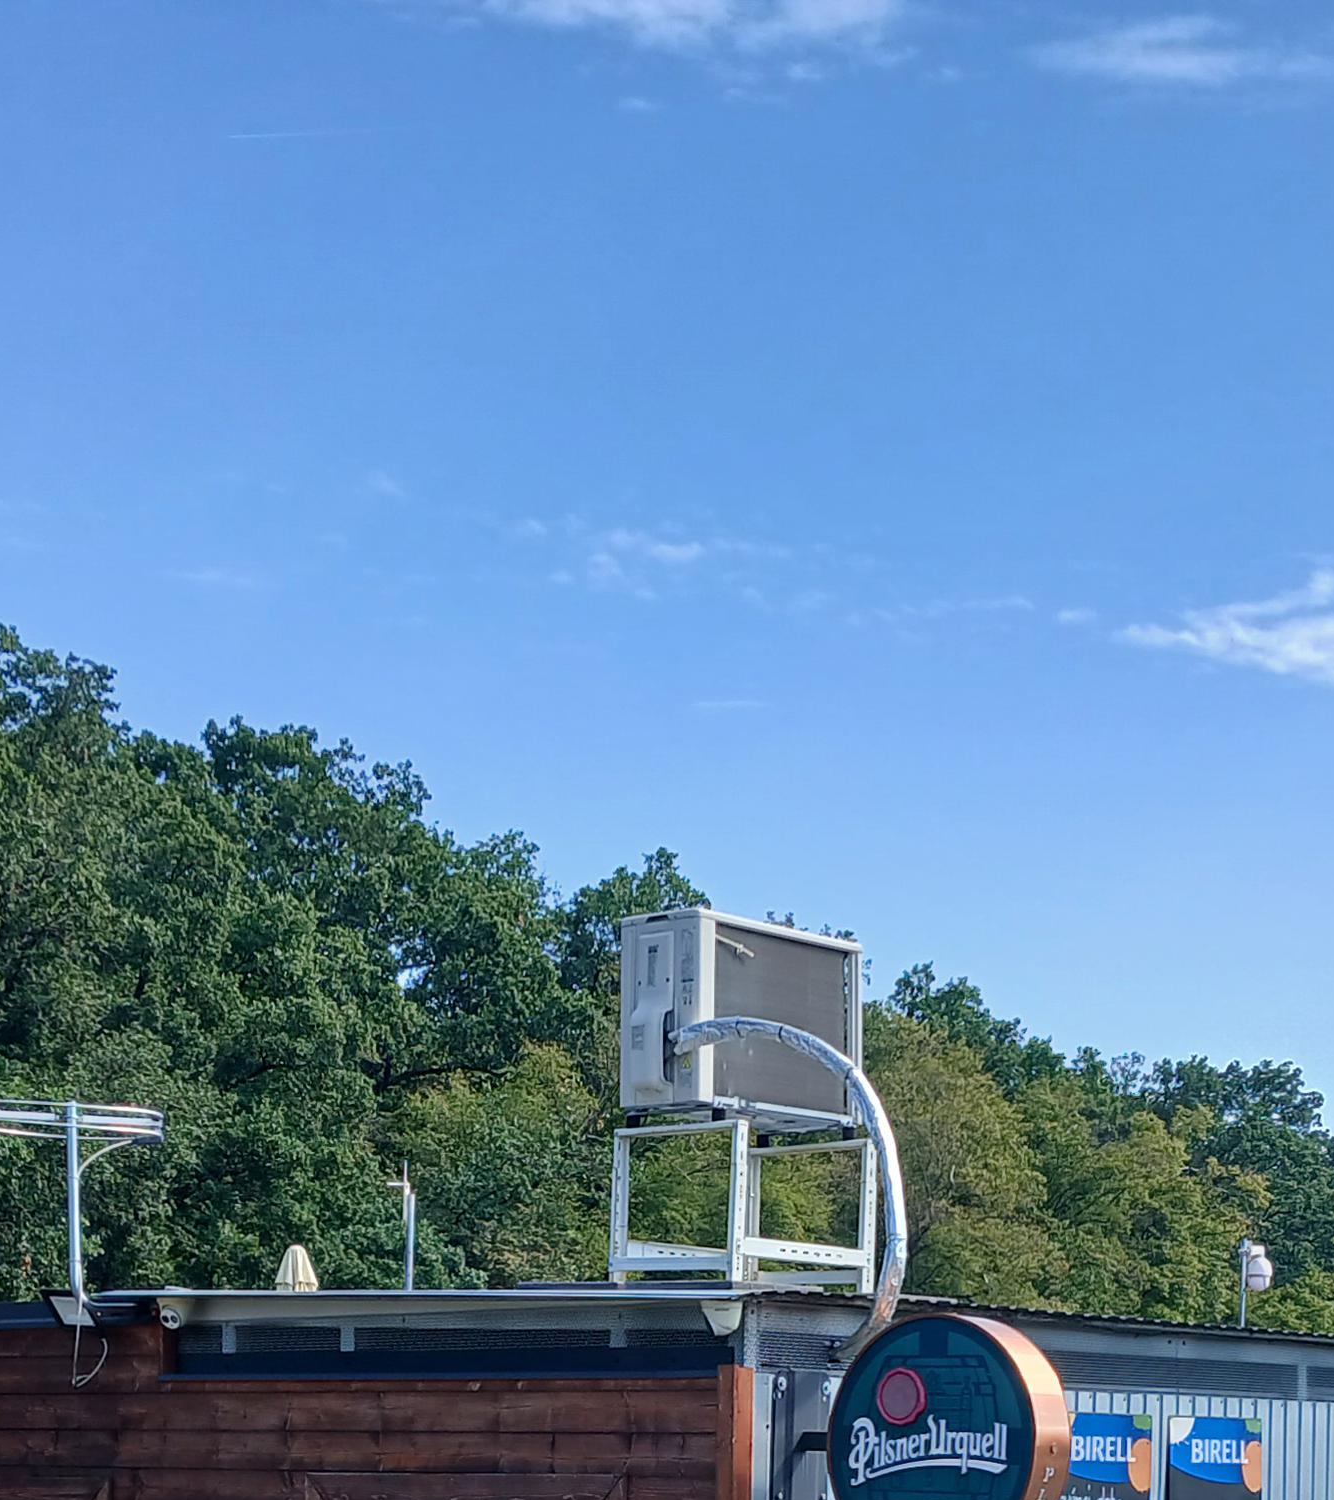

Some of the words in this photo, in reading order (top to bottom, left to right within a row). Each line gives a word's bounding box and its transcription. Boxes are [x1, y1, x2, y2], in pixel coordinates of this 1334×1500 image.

[849, 1417, 929, 1486] Pilsner
[927, 1414, 1008, 1475] Urquell
[1071, 1435, 1137, 1463] BIRELL
[1190, 1438, 1249, 1465] BIRELL
